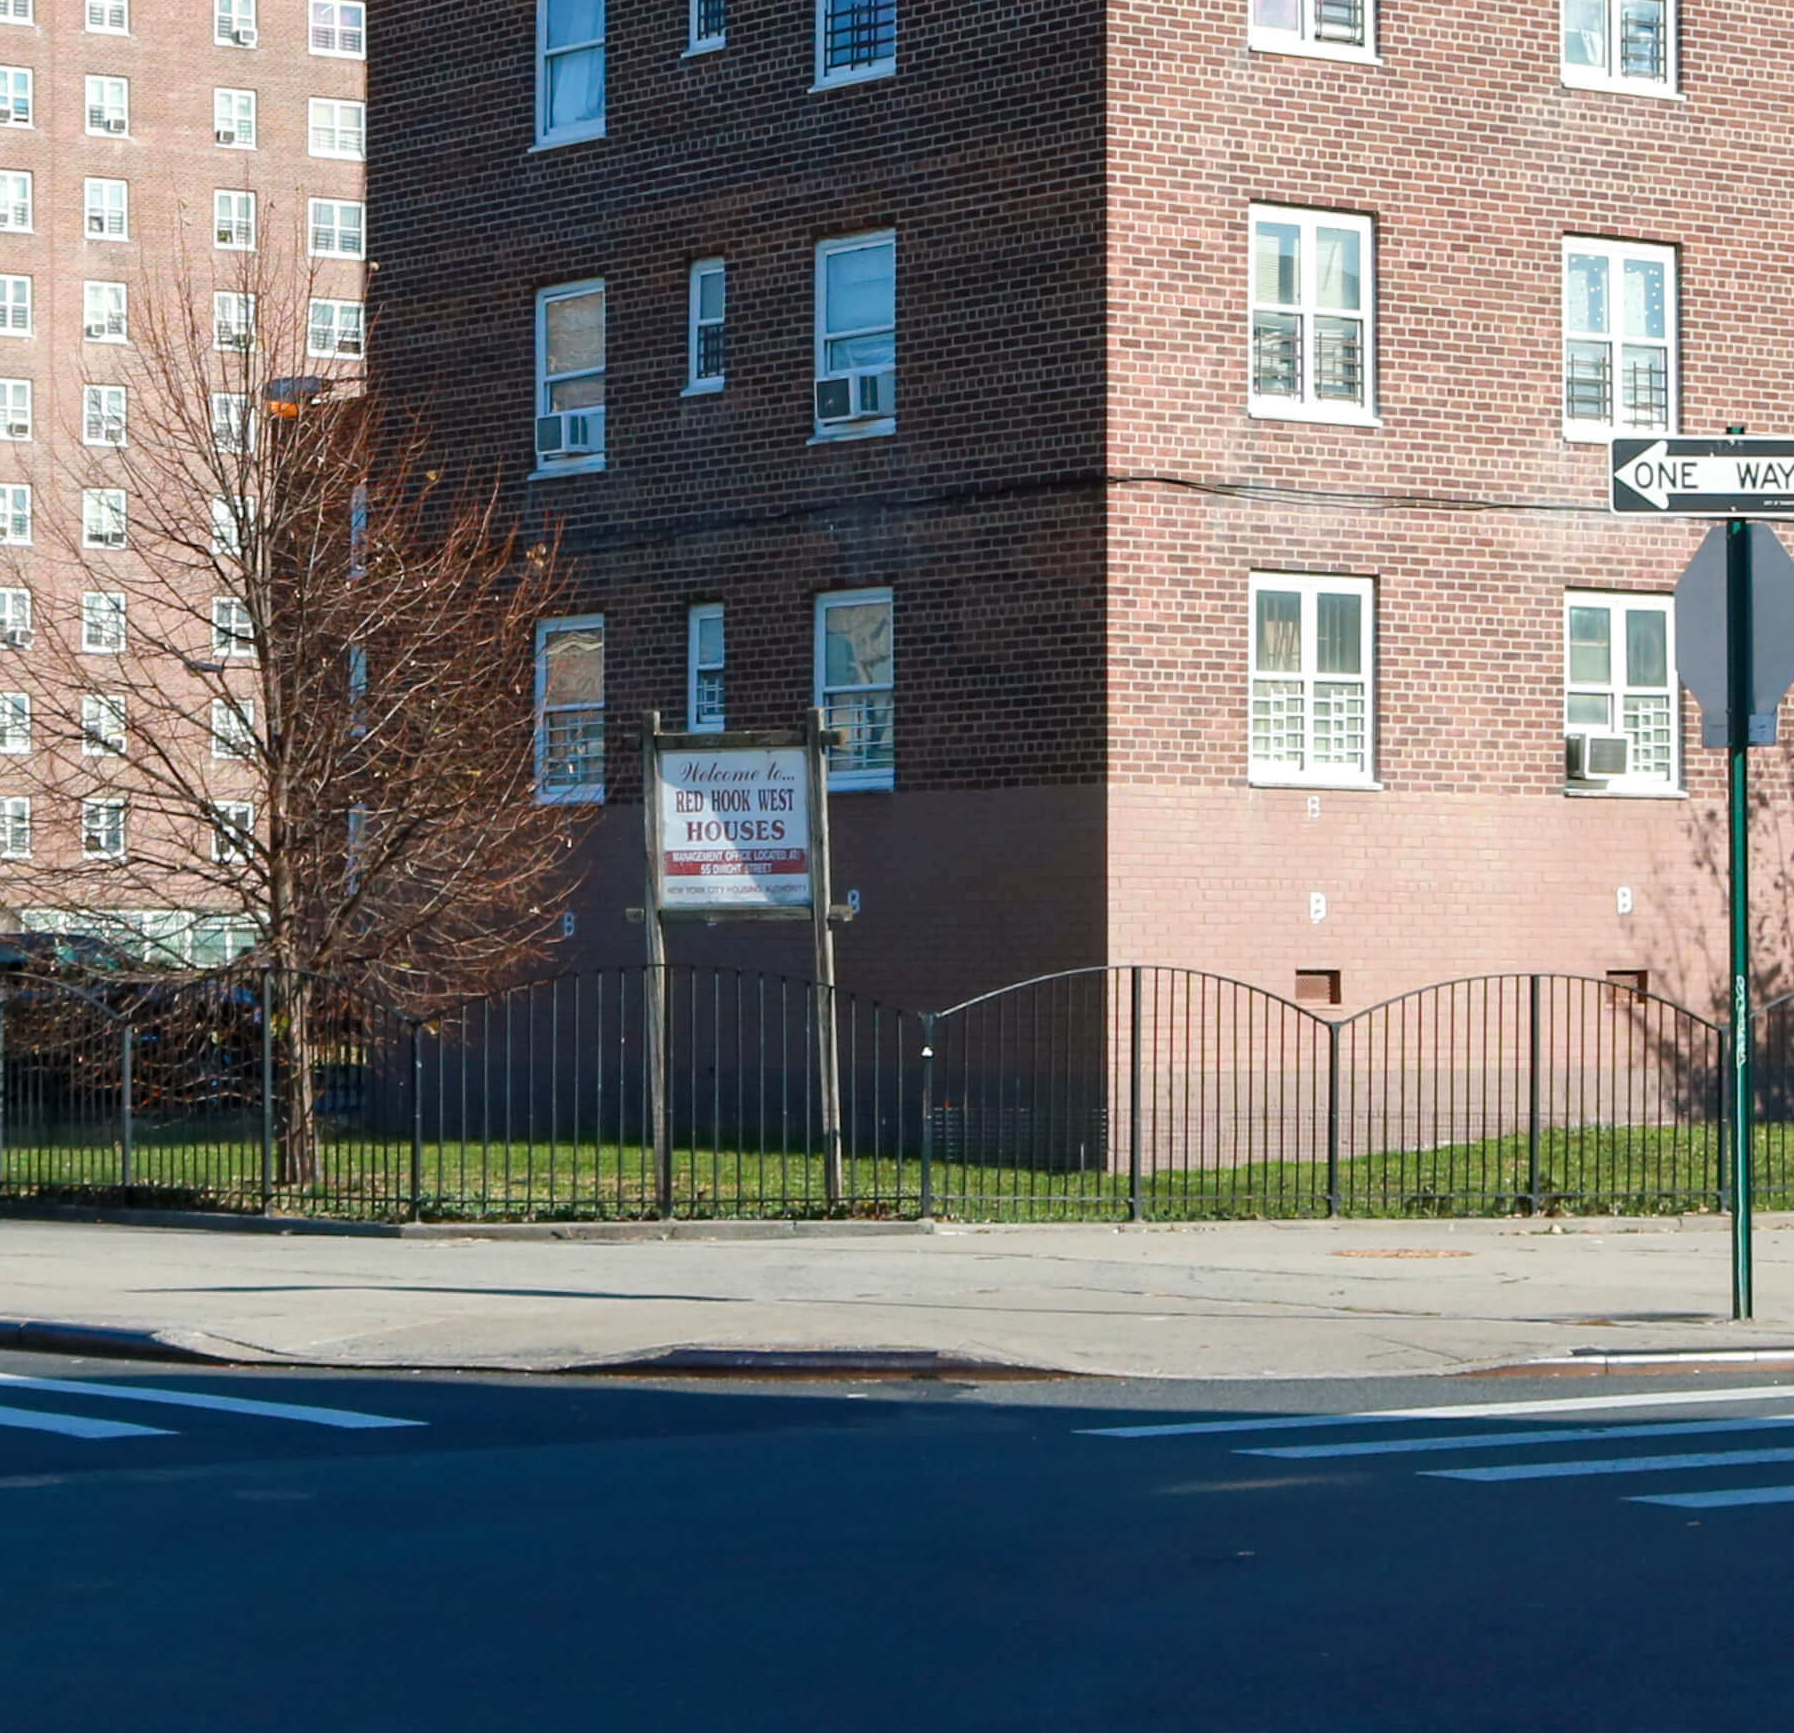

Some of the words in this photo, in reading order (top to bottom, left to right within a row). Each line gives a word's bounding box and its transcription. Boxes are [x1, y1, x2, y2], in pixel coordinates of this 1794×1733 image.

[1634, 461, 1698, 489] ONE
[681, 761, 759, 783] Welcome
[676, 790, 703, 813] RED
[711, 789, 750, 811] HOOK
[758, 788, 794, 811] WEST
[686, 819, 786, 842] HOUSES
[672, 851, 723, 862] MANAGEMENT
[724, 850, 753, 862] OFFICE
[754, 850, 787, 861] LOCATED
[745, 863, 772, 874] STREET
[708, 886, 725, 894] CITY
[1617, 886, 1633, 913] B
[564, 912, 575, 937] B
